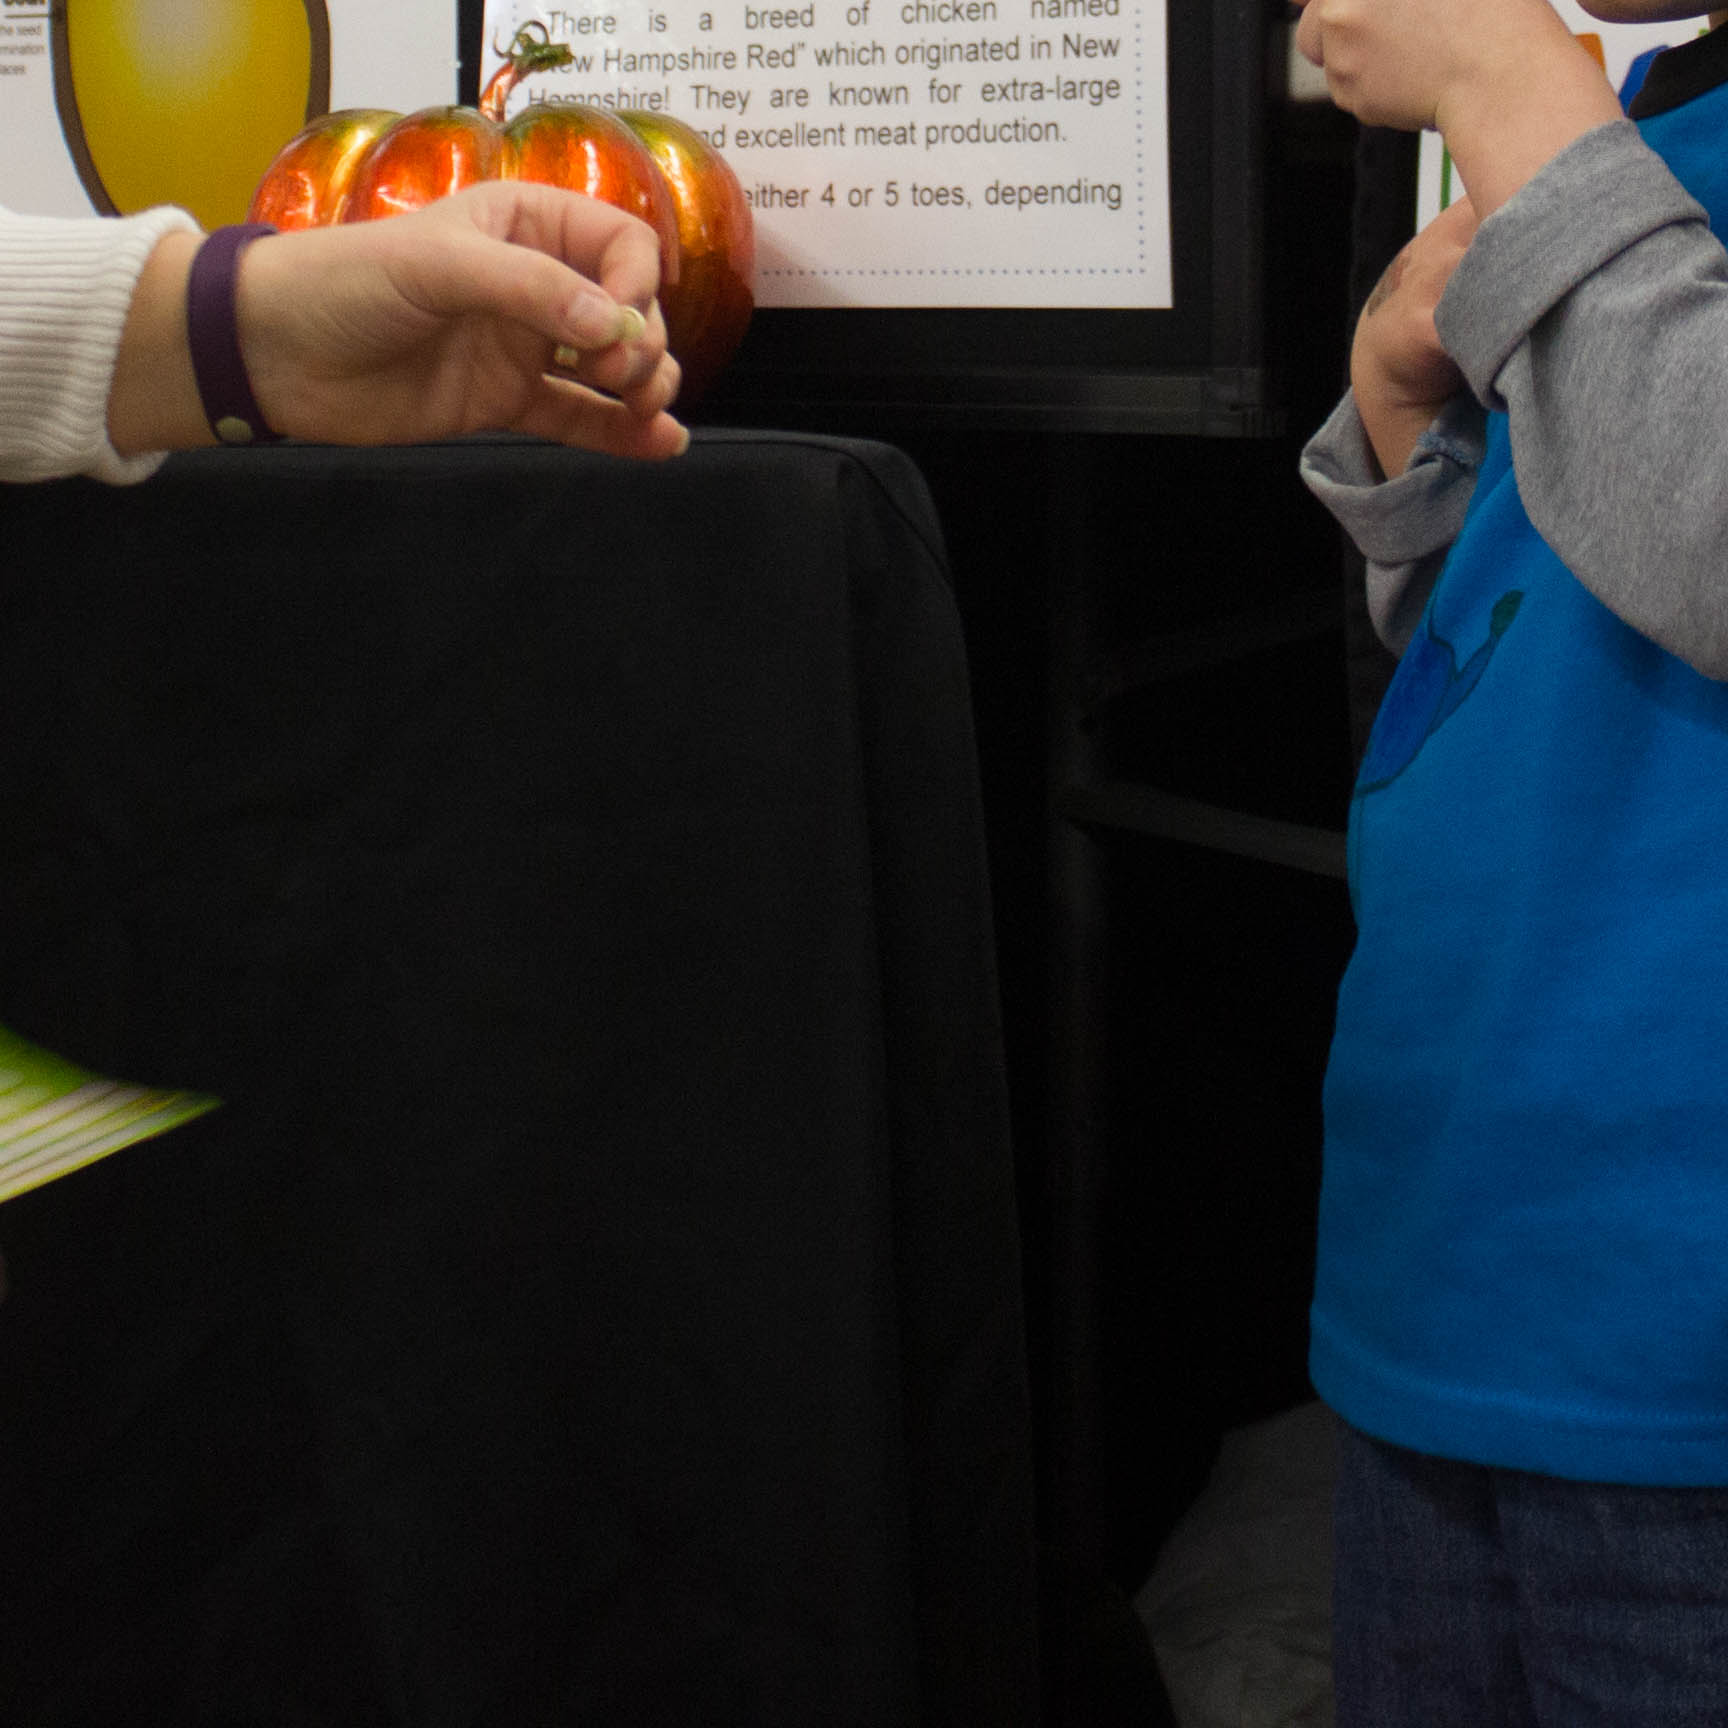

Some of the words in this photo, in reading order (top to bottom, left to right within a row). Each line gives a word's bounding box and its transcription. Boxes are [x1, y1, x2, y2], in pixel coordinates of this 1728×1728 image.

[602, 45, 738, 78] Hampshire
[813, 39, 887, 68] which
[894, 34, 1021, 72] originated
[1029, 34, 1053, 61] in
[1061, 32, 1121, 60] New
[819, 181, 836, 208] 4
[847, 186, 875, 209] or
[884, 180, 900, 208] 5
[909, 182, 972, 210] toes,
[983, 177, 1123, 212] depending
